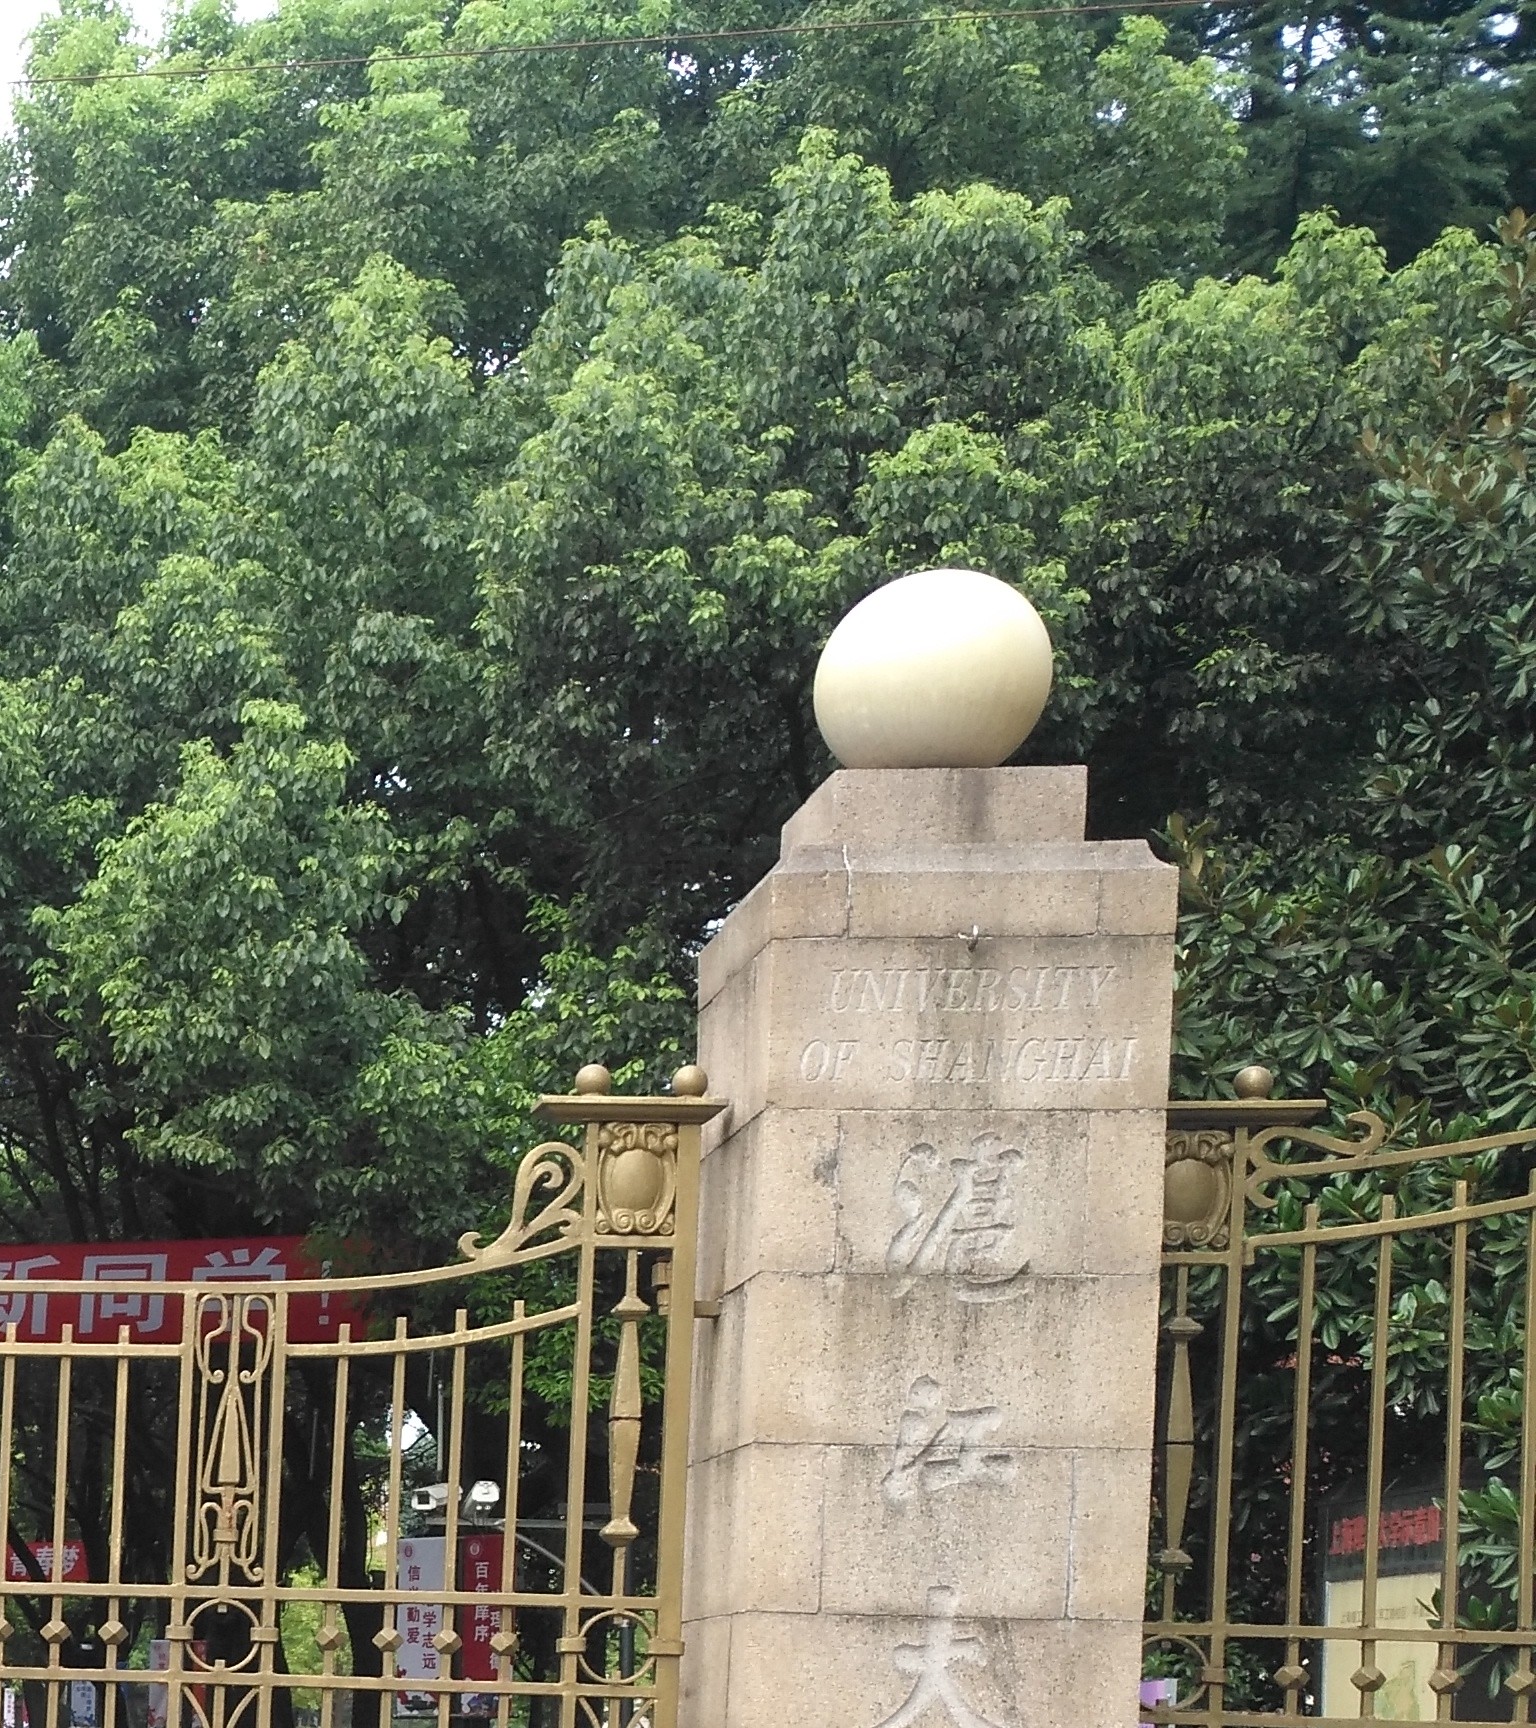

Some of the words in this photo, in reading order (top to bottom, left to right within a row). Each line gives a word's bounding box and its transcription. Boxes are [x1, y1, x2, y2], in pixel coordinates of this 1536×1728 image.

[827, 964, 1119, 1015] UNIVERSITY
[799, 1037, 862, 1084] OF
[890, 1034, 1139, 1085] SHANGHAI
[406, 1565, 421, 1645] 信勤爱
[422, 1602, 437, 1670] 学志远
